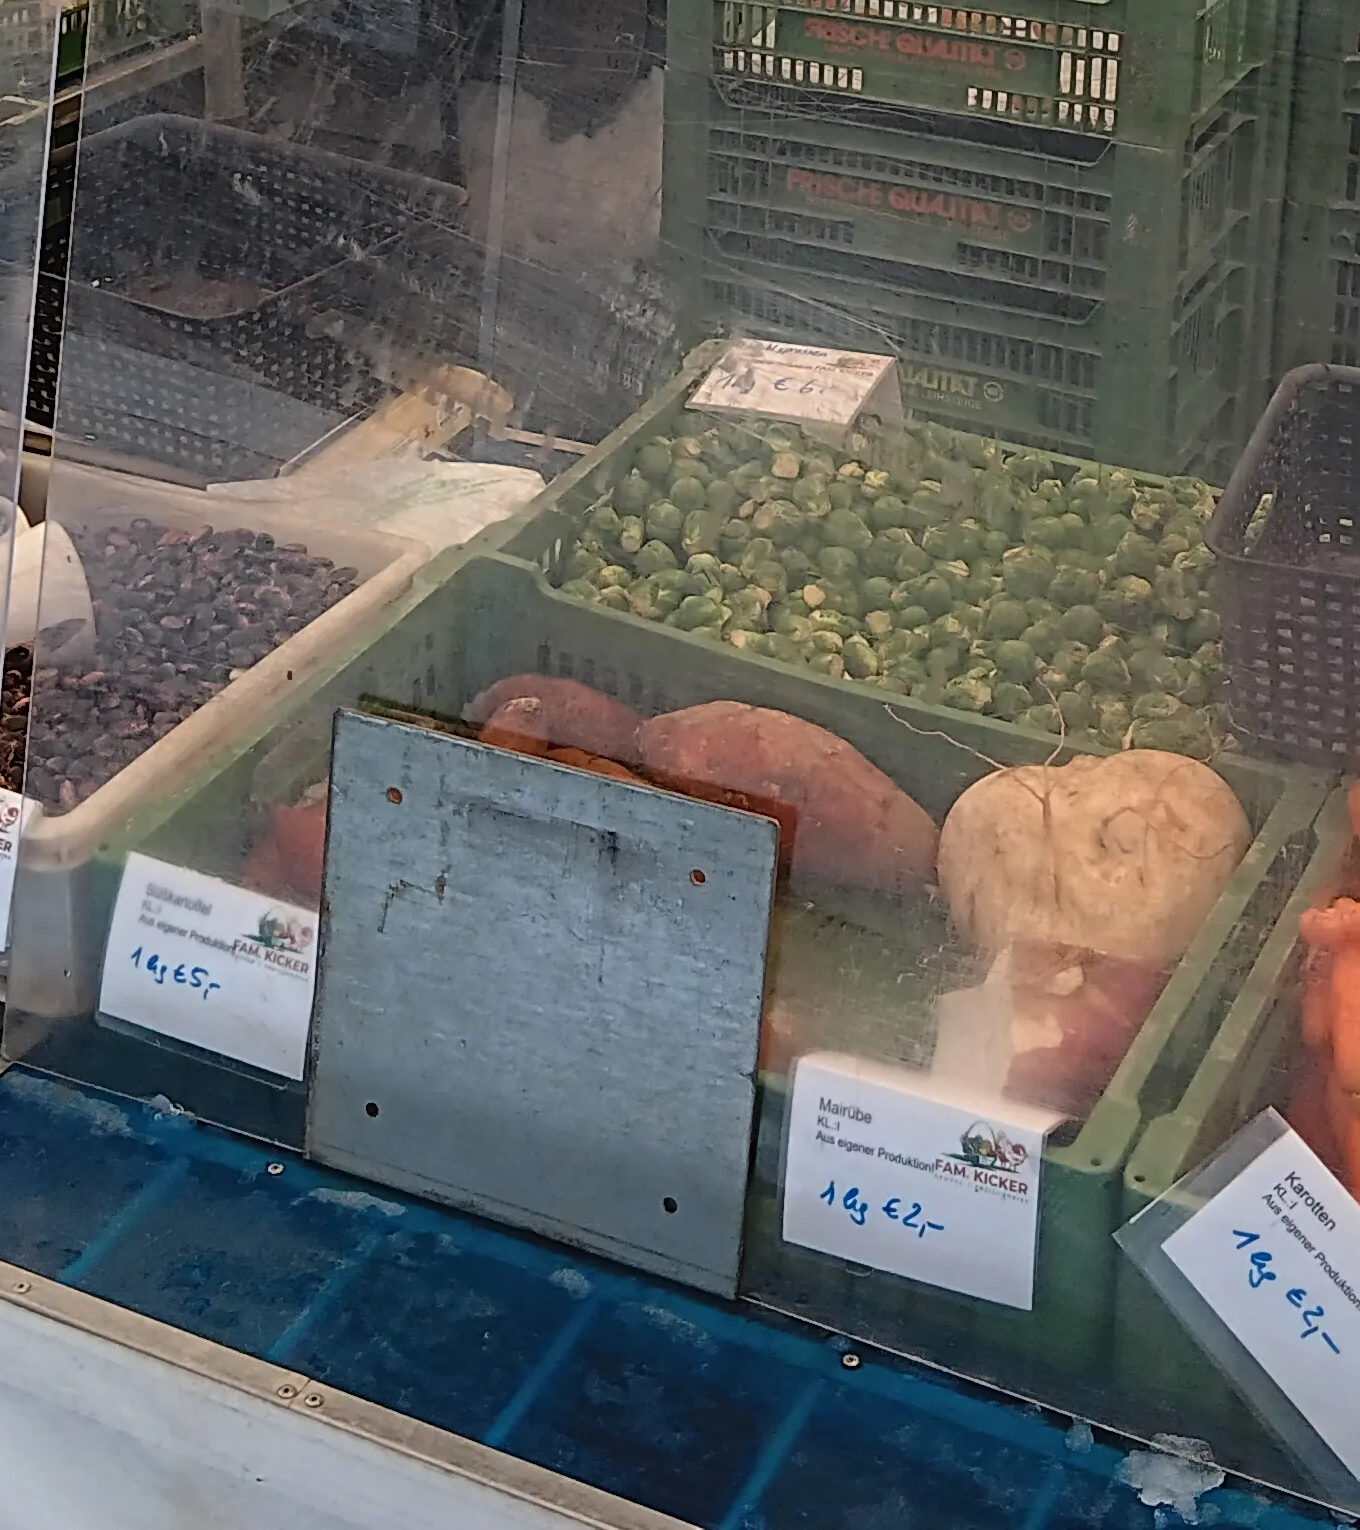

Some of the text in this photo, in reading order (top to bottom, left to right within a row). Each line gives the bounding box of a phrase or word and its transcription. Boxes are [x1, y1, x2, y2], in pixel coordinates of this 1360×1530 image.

[264, 950, 309, 974] KICKER
[819, 1097, 872, 1124] Mairübe
[816, 1130, 835, 1145] Aus
[837, 1137, 875, 1157] eigener
[934, 1158, 970, 1179] FAM.
[974, 1171, 1028, 1195] KICKER
[1284, 1171, 1336, 1232] Karotten
[1262, 1193, 1281, 1216] Aus
[1281, 1214, 1316, 1254] eigener
